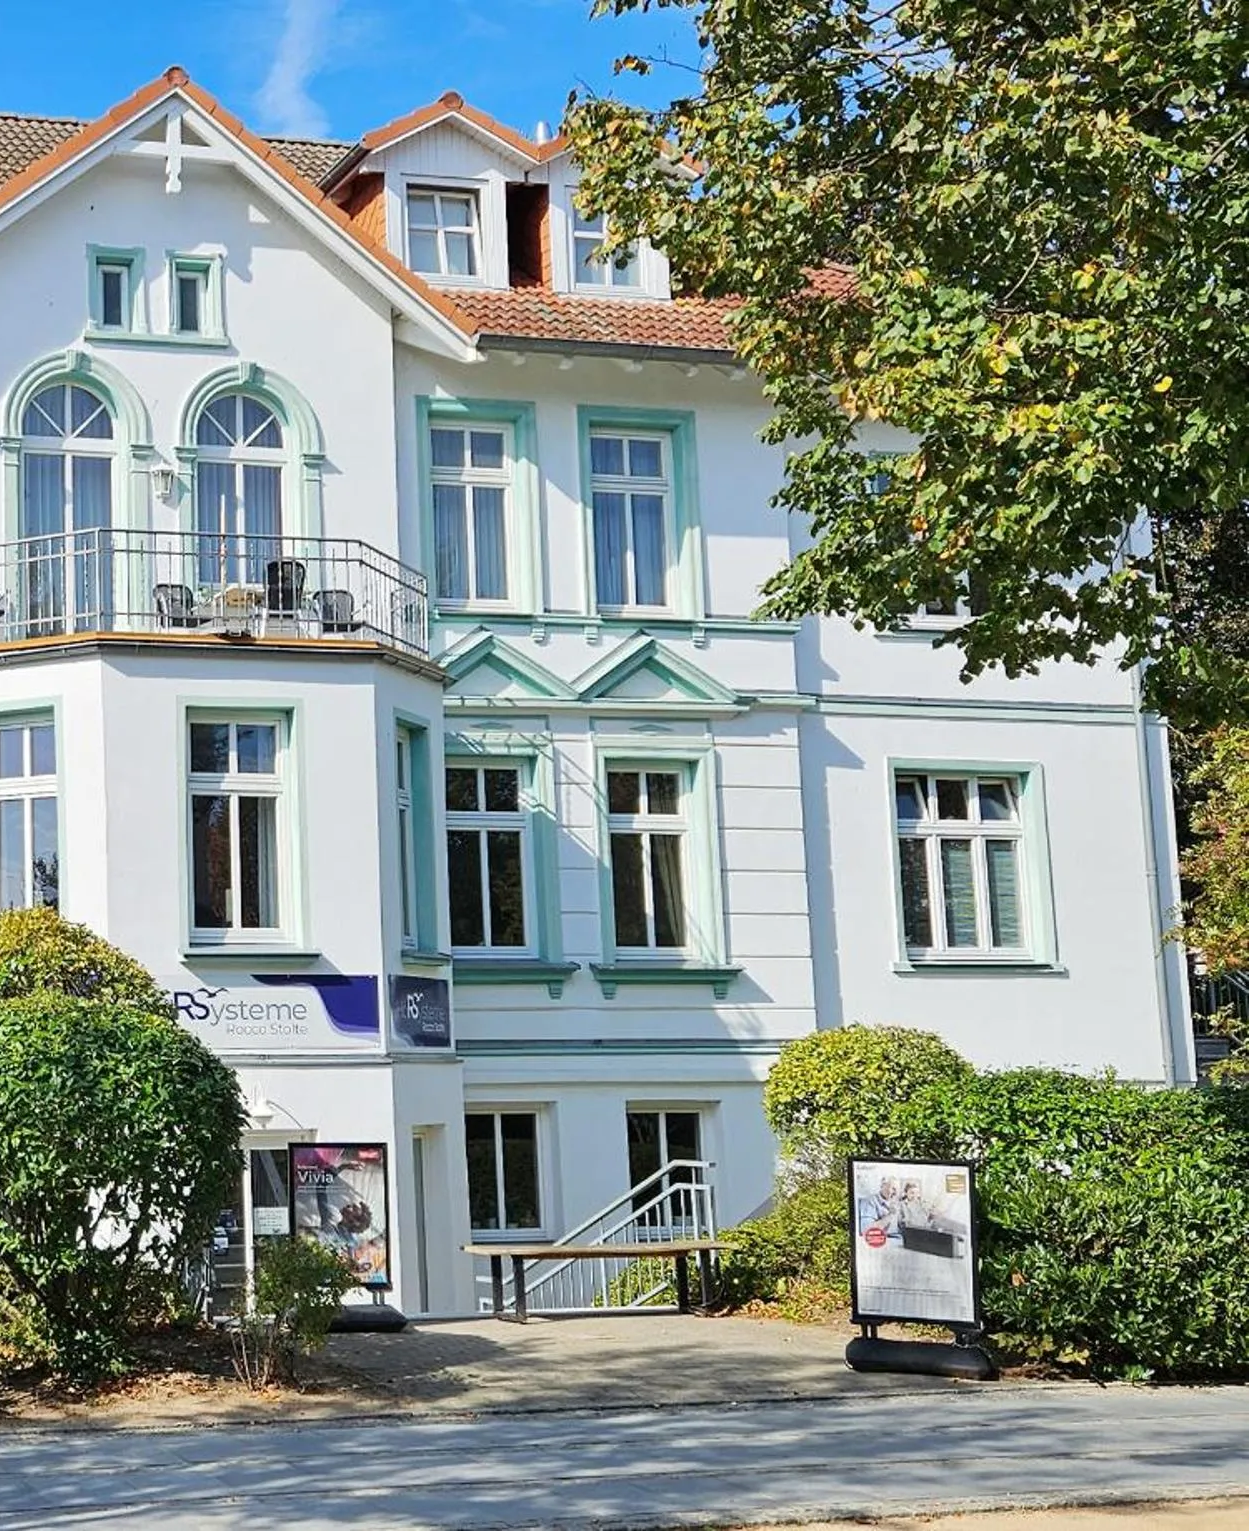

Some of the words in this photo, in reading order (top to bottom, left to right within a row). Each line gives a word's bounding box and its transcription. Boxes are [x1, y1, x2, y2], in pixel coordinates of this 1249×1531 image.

[227, 1023, 267, 1035] Rocco
[270, 1023, 308, 1035] Stolte
[297, 1170, 334, 1184] Vivia
